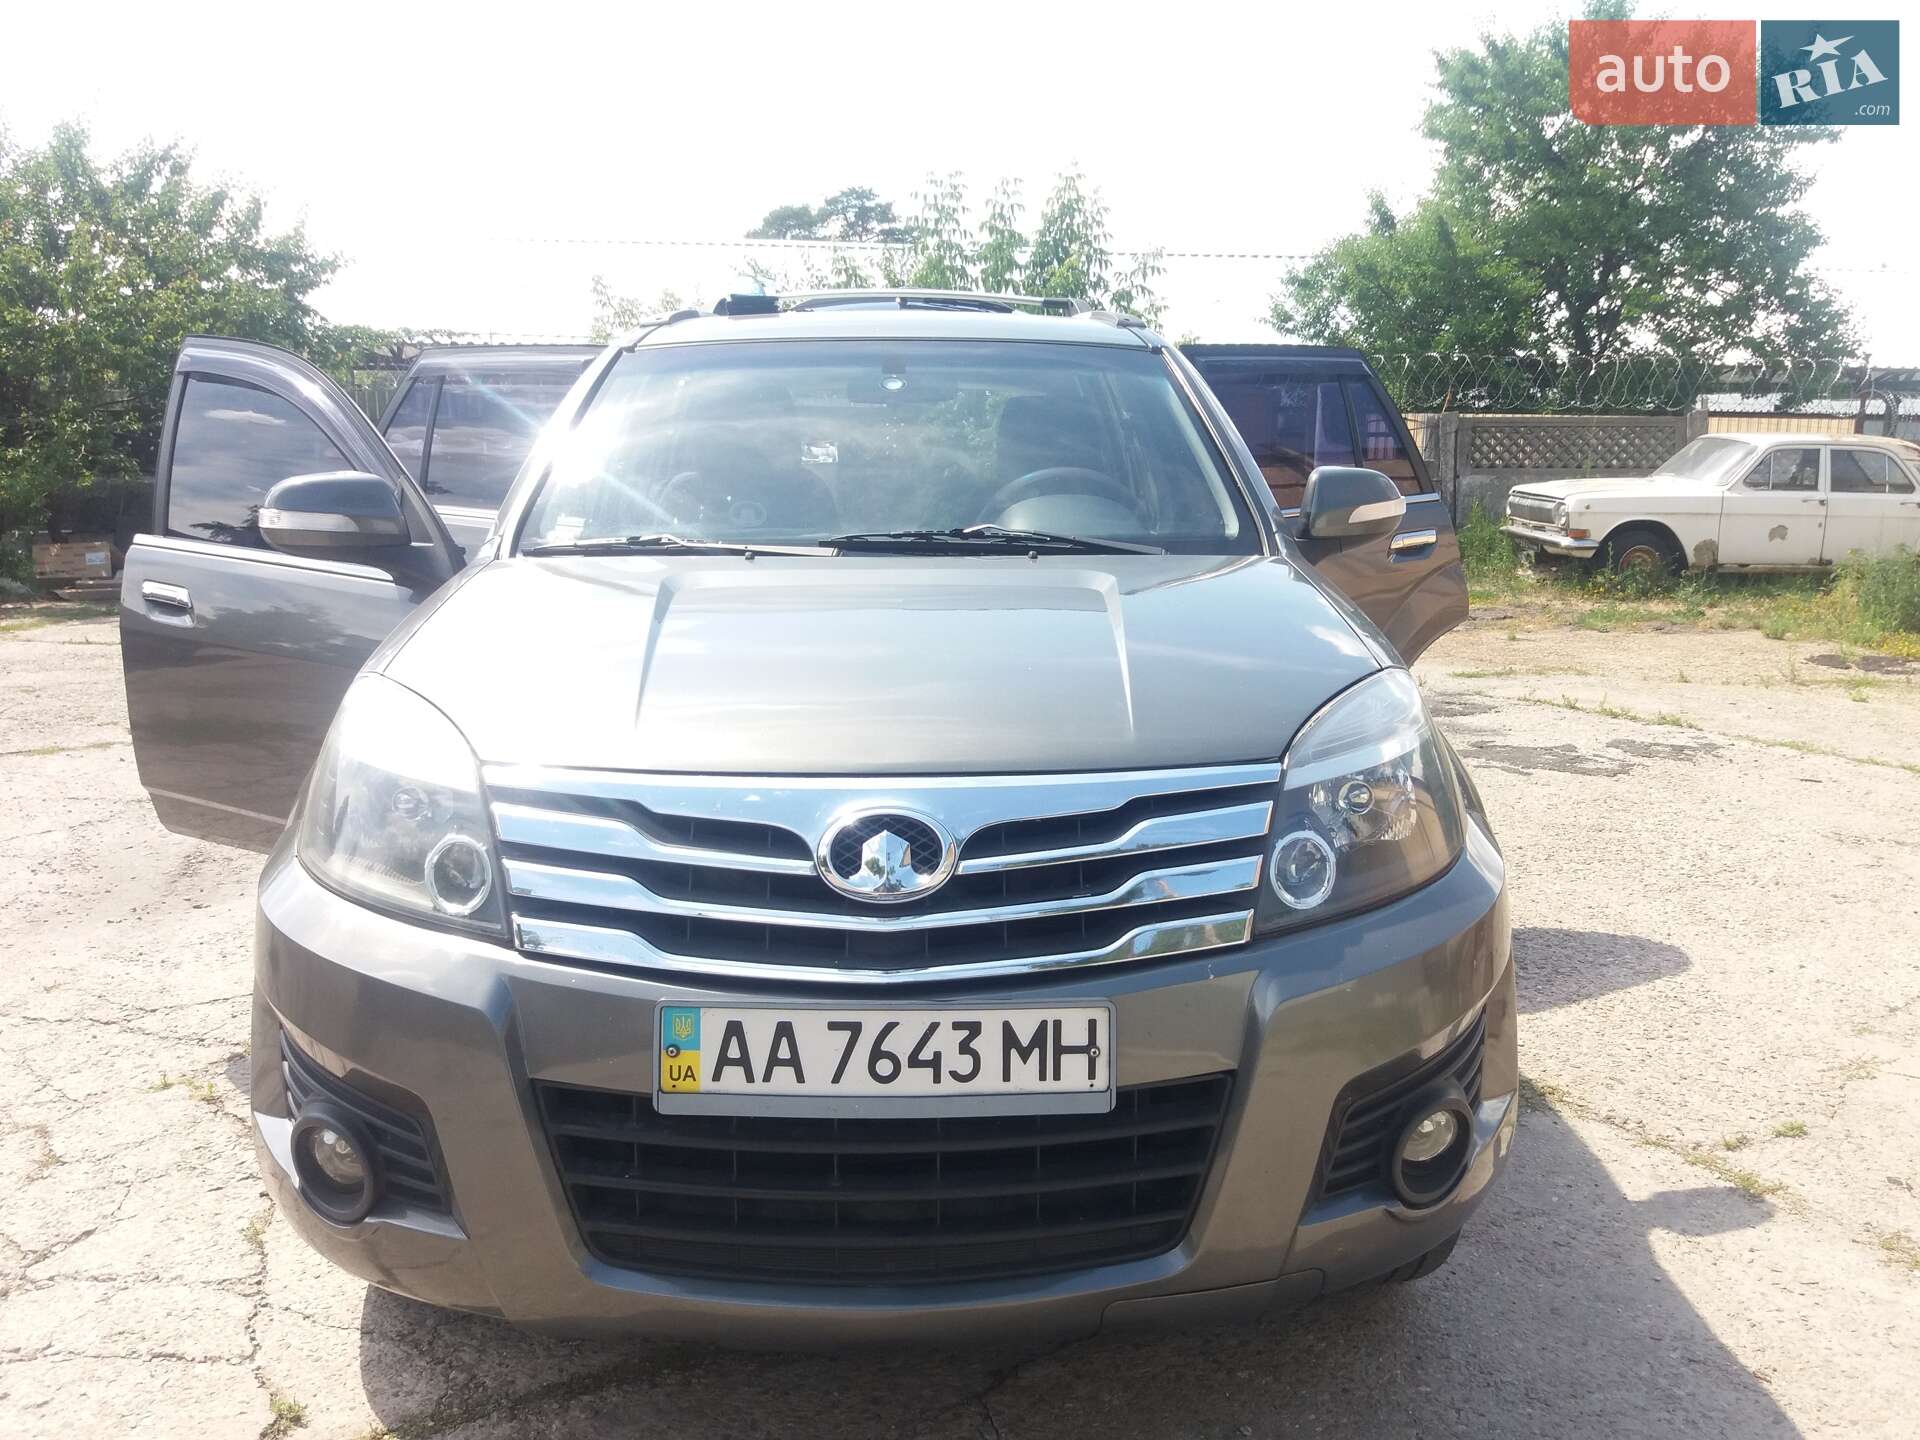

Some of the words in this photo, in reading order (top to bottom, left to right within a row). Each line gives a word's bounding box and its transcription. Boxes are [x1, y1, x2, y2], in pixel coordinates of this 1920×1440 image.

[711, 1020, 805, 1084] AA
[827, 1020, 982, 1085] 7643
[1002, 1018, 1097, 1082] MH
[669, 1064, 696, 1082] UA
